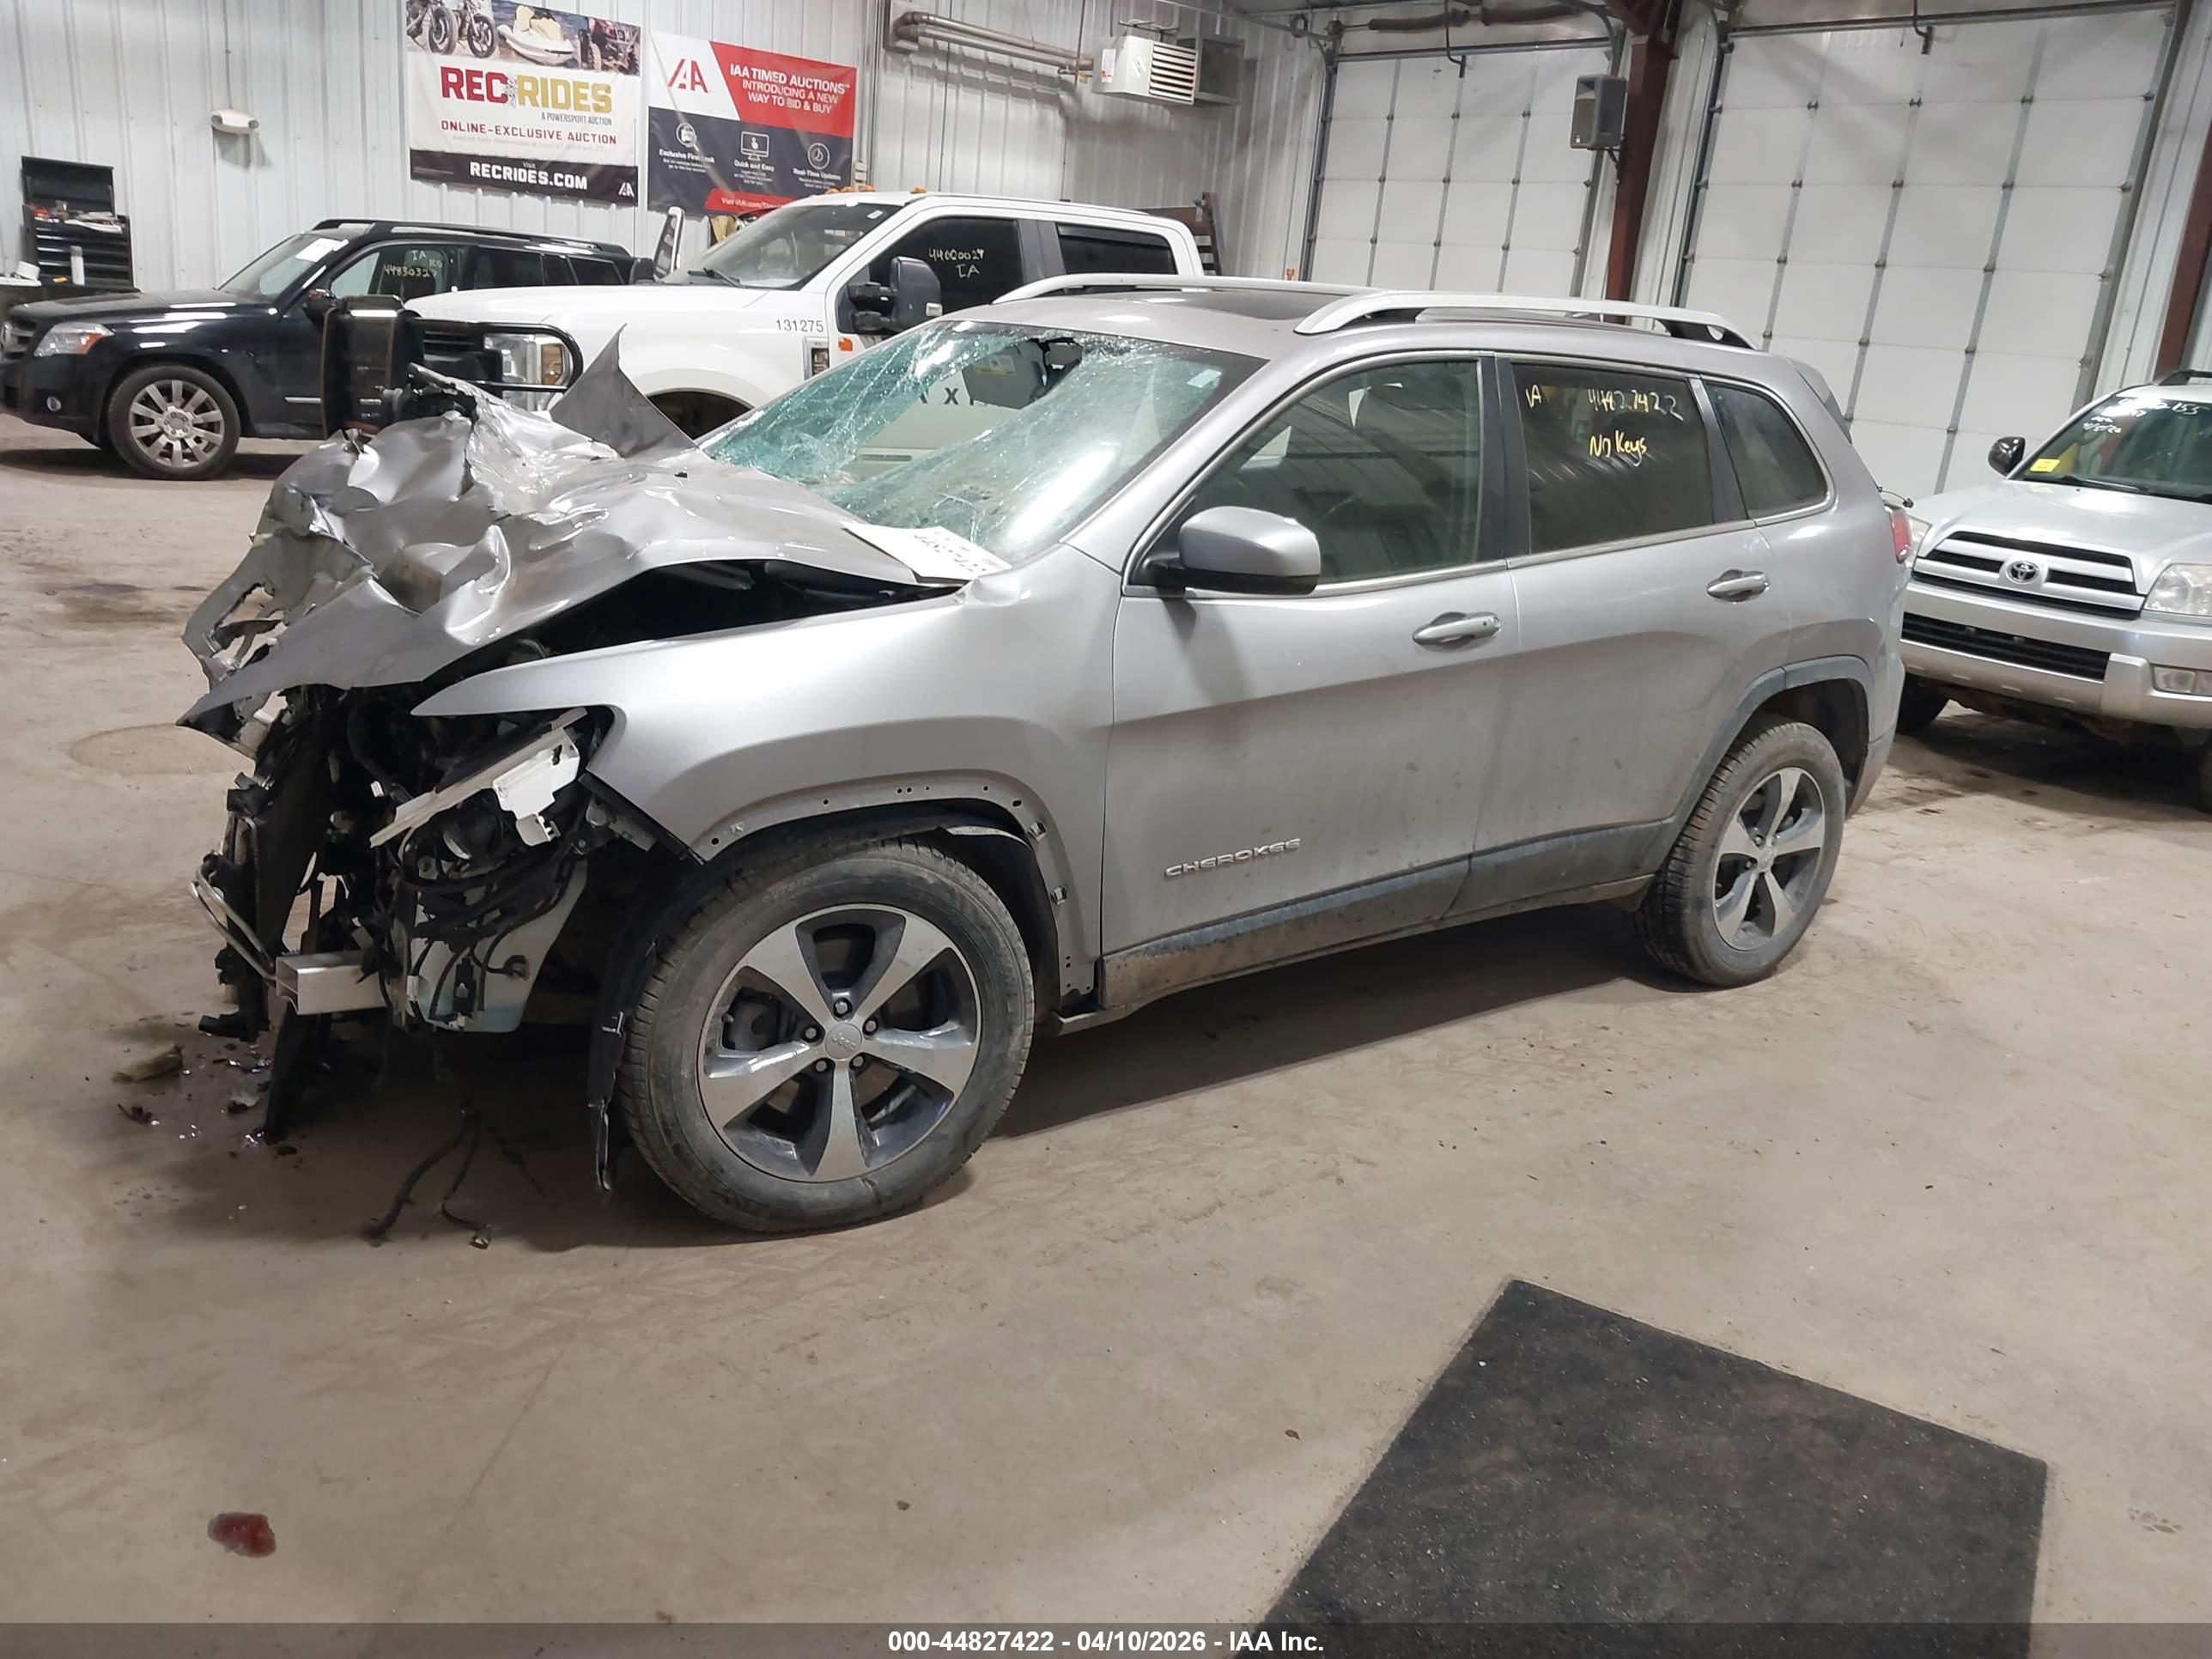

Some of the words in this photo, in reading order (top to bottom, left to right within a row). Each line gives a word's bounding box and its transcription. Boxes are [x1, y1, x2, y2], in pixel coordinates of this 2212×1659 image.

[730, 64, 750, 78] IAA
[751, 68, 787, 84] TIMED
[441, 66, 508, 104] REC
[516, 75, 612, 113] RIDES
[742, 79, 805, 99] INTRODUCING
[808, 90, 817, 100] A
[817, 93, 839, 103] NEW
[748, 91, 770, 103] WAY
[771, 95, 784, 106] TO
[787, 98, 801, 109] BID
[803, 101, 811, 111] &
[812, 103, 832, 113] BUY
[541, 112, 546, 120] A
[547, 112, 586, 124] POWERSPORT
[588, 116, 612, 126] AUCTION
[441, 120, 562, 140] ONLINE-EXCLUSIVE
[568, 131, 617, 144] AUCTION
[469, 161, 588, 190] RECRIDES.COM
[776, 319, 824, 332] 131275
[1615, 429, 1648, 467] Keys
[1164, 837, 1302, 878] CHEROKEE
